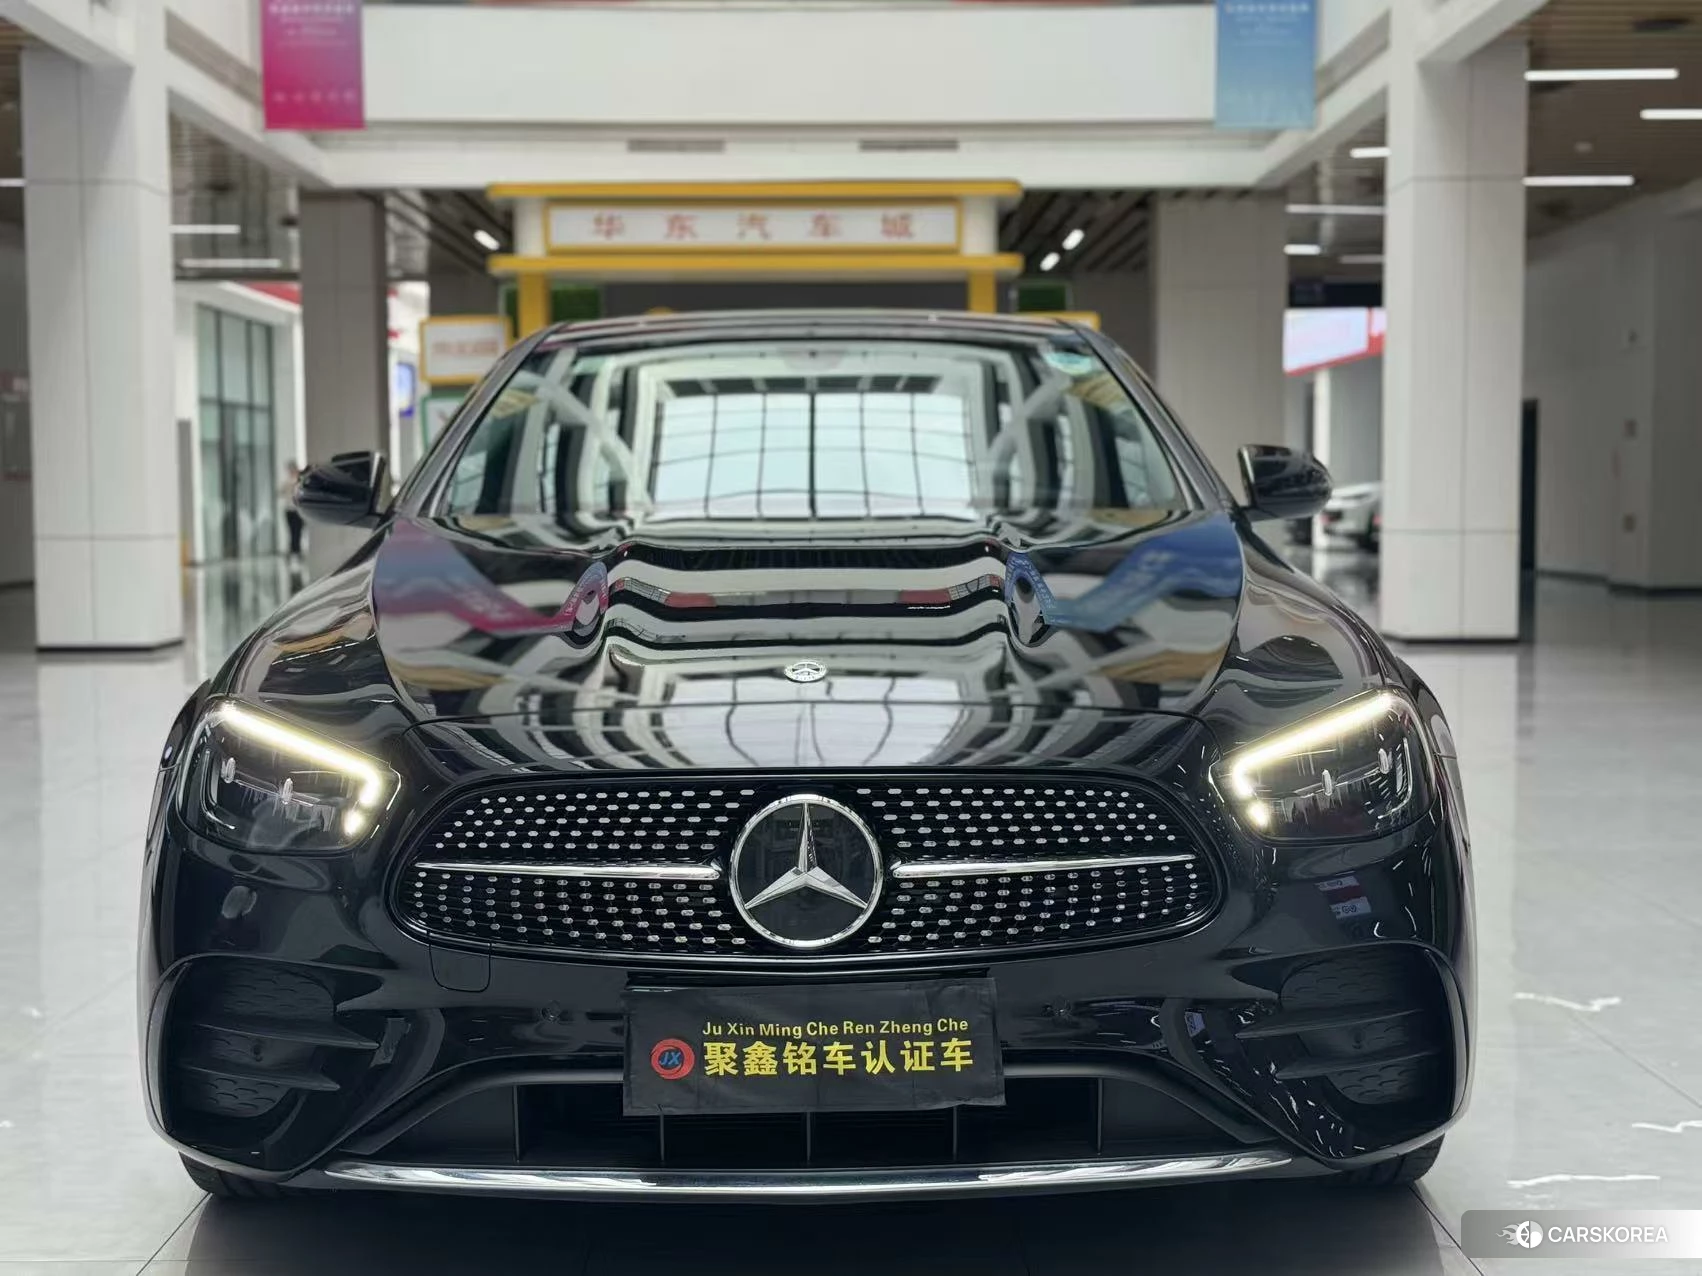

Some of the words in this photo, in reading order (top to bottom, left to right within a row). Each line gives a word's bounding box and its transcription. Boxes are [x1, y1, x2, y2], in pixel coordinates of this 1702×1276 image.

[702, 1022, 722, 1036] Ju
[727, 1022, 755, 1036] Xin
[759, 1023, 802, 1039] Ming
[806, 1021, 839, 1036] Che
[843, 1021, 875, 1034] Ren
[879, 1020, 933, 1037] Zheng
[937, 1018, 969, 1032] Che
[703, 1038, 973, 1076] 聚鑫铭车认证车
